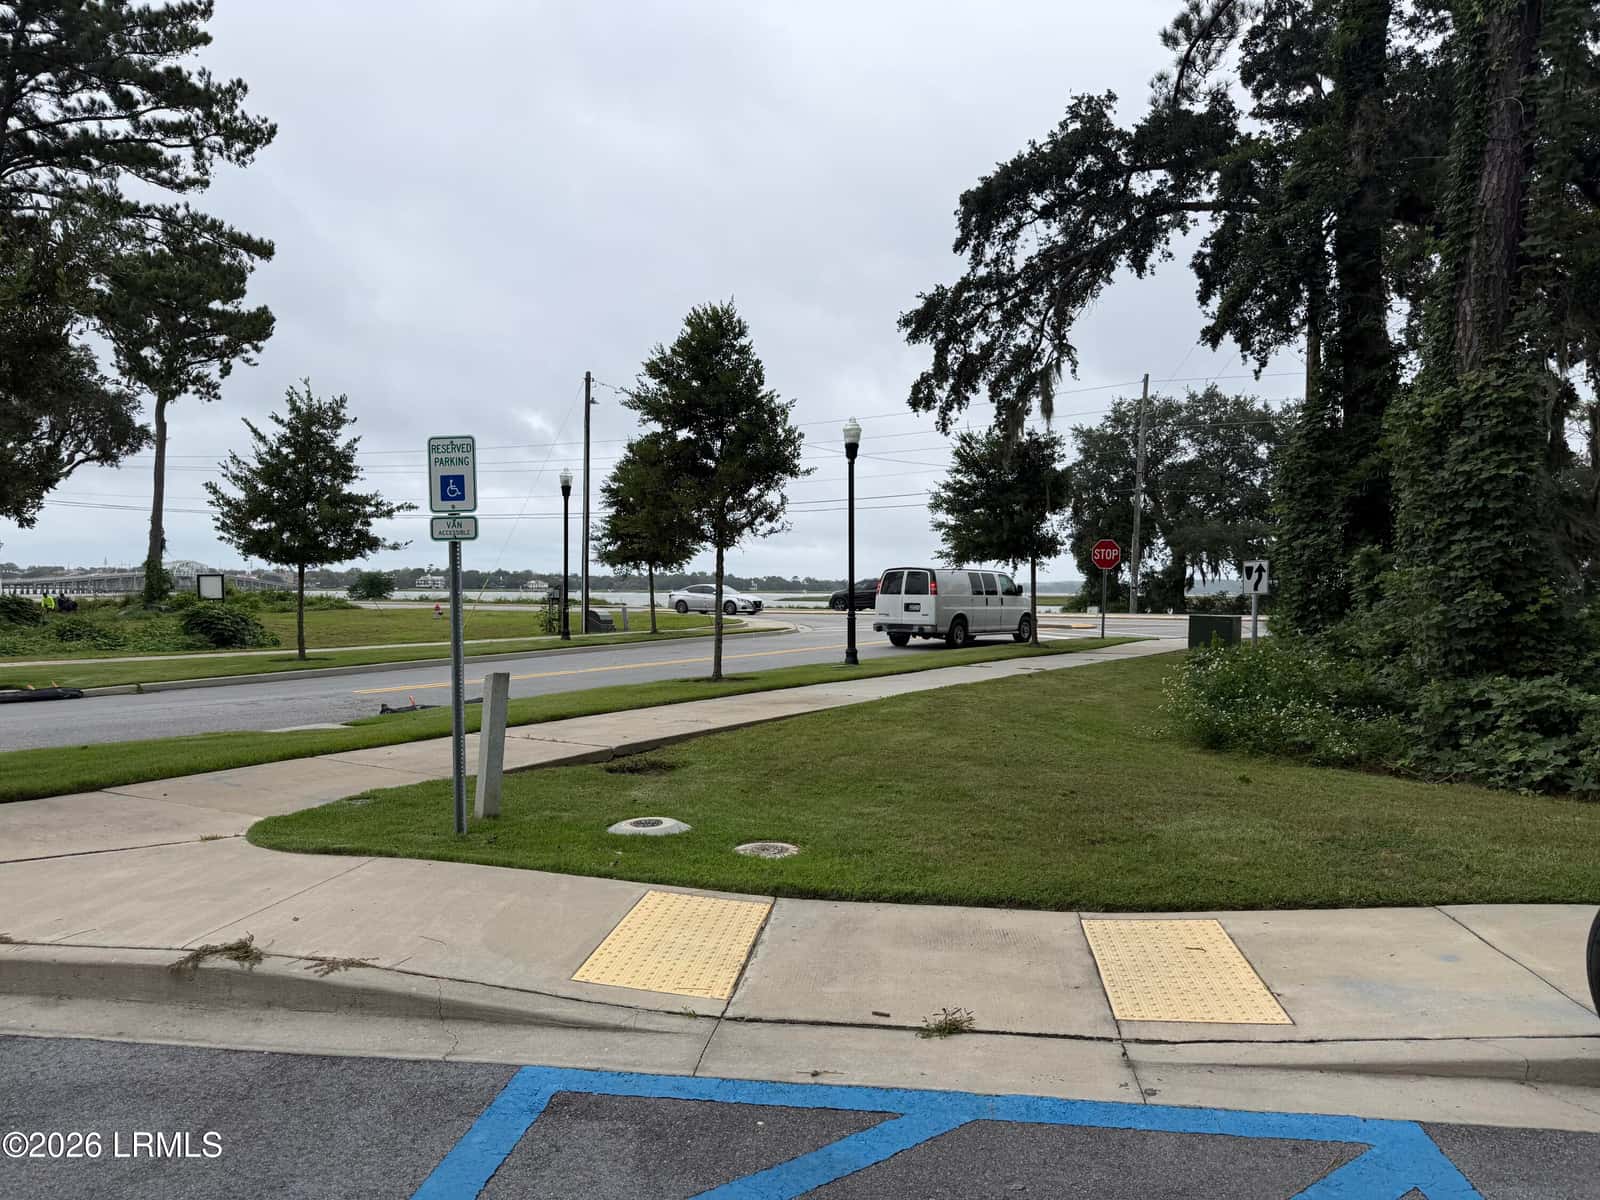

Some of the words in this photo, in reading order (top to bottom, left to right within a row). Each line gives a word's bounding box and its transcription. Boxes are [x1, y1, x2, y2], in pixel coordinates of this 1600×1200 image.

[431, 443, 472, 454] RESERVED
[434, 456, 470, 467] PARKING
[446, 520, 463, 529] VAN
[1094, 548, 1119, 560] STOP
